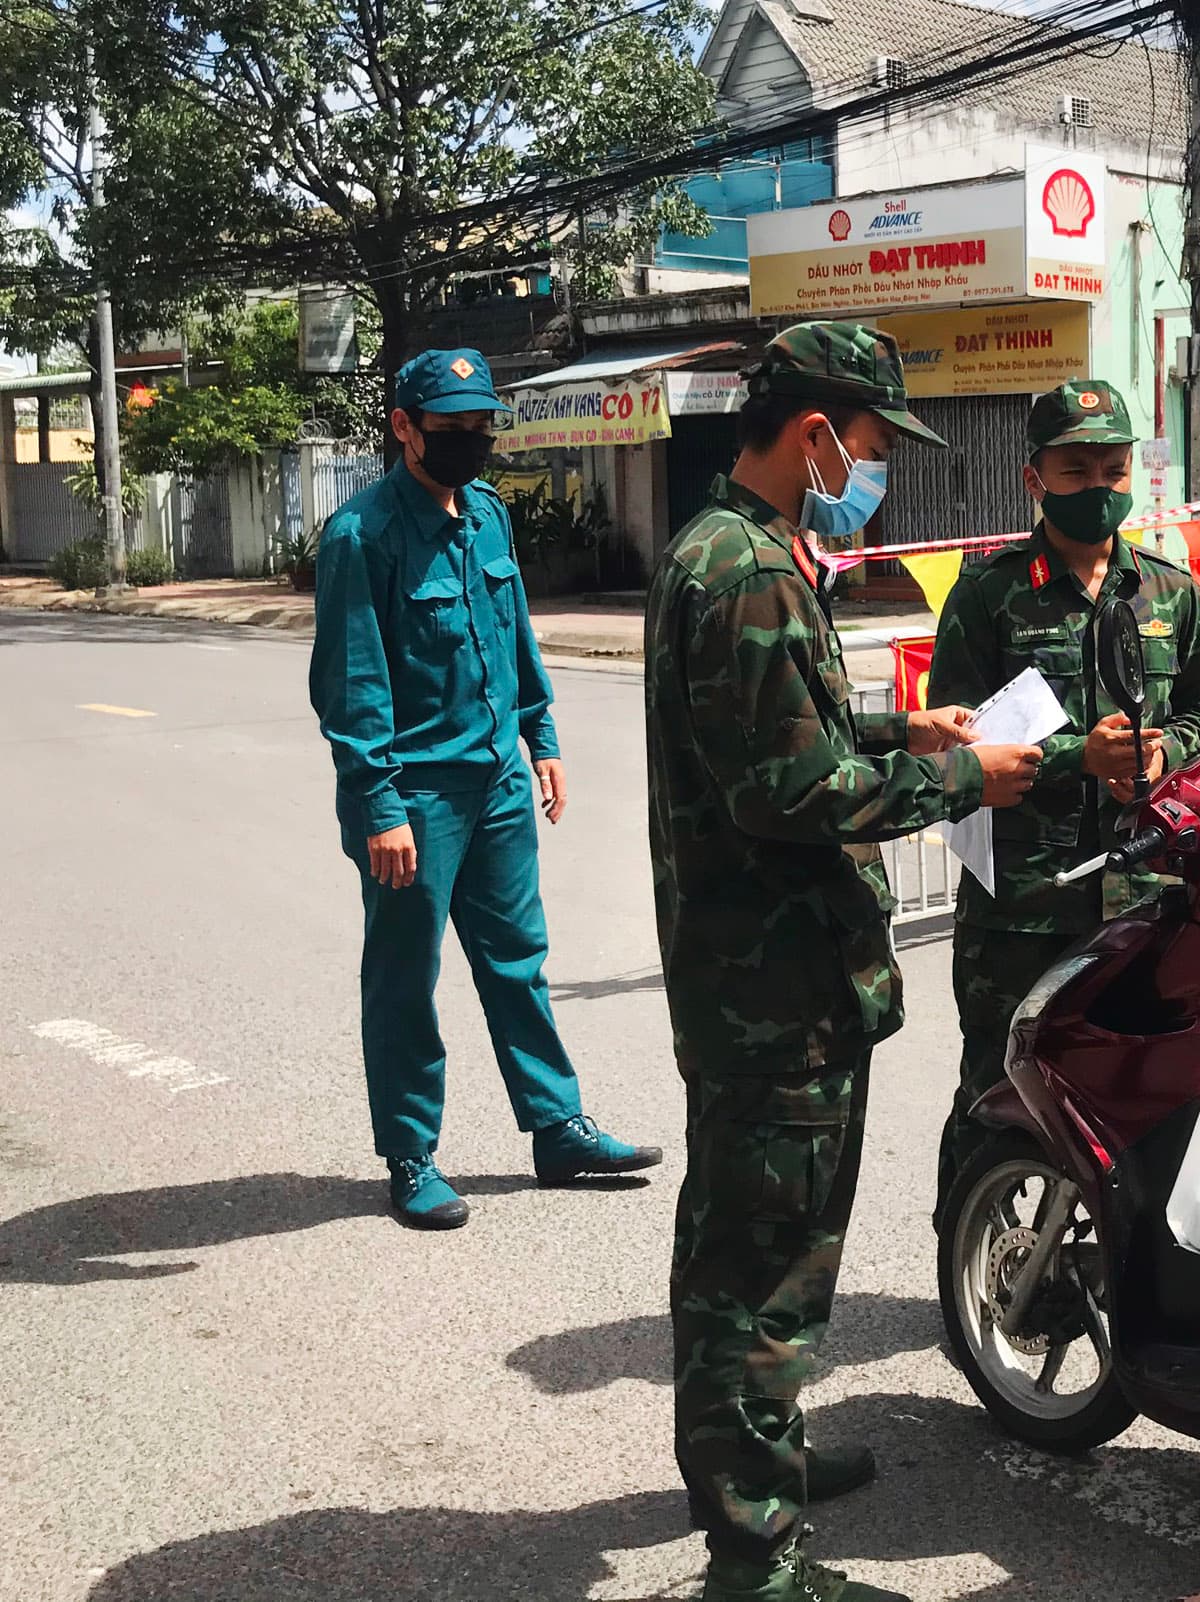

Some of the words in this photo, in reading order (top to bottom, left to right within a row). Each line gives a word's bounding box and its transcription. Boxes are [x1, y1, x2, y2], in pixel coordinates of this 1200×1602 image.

[884, 199, 907, 213] Shell
[868, 211, 923, 230] ADVANCE
[868, 247, 912, 277] ĐẠT
[913, 240, 986, 272] THỊNH
[1034, 272, 1059, 293] ĐẠT
[1063, 275, 1102, 296] THỊNH
[955, 333, 989, 355] ĐẠT
[994, 328, 1053, 353] THỊNH
[901, 349, 945, 365] DVANCE
